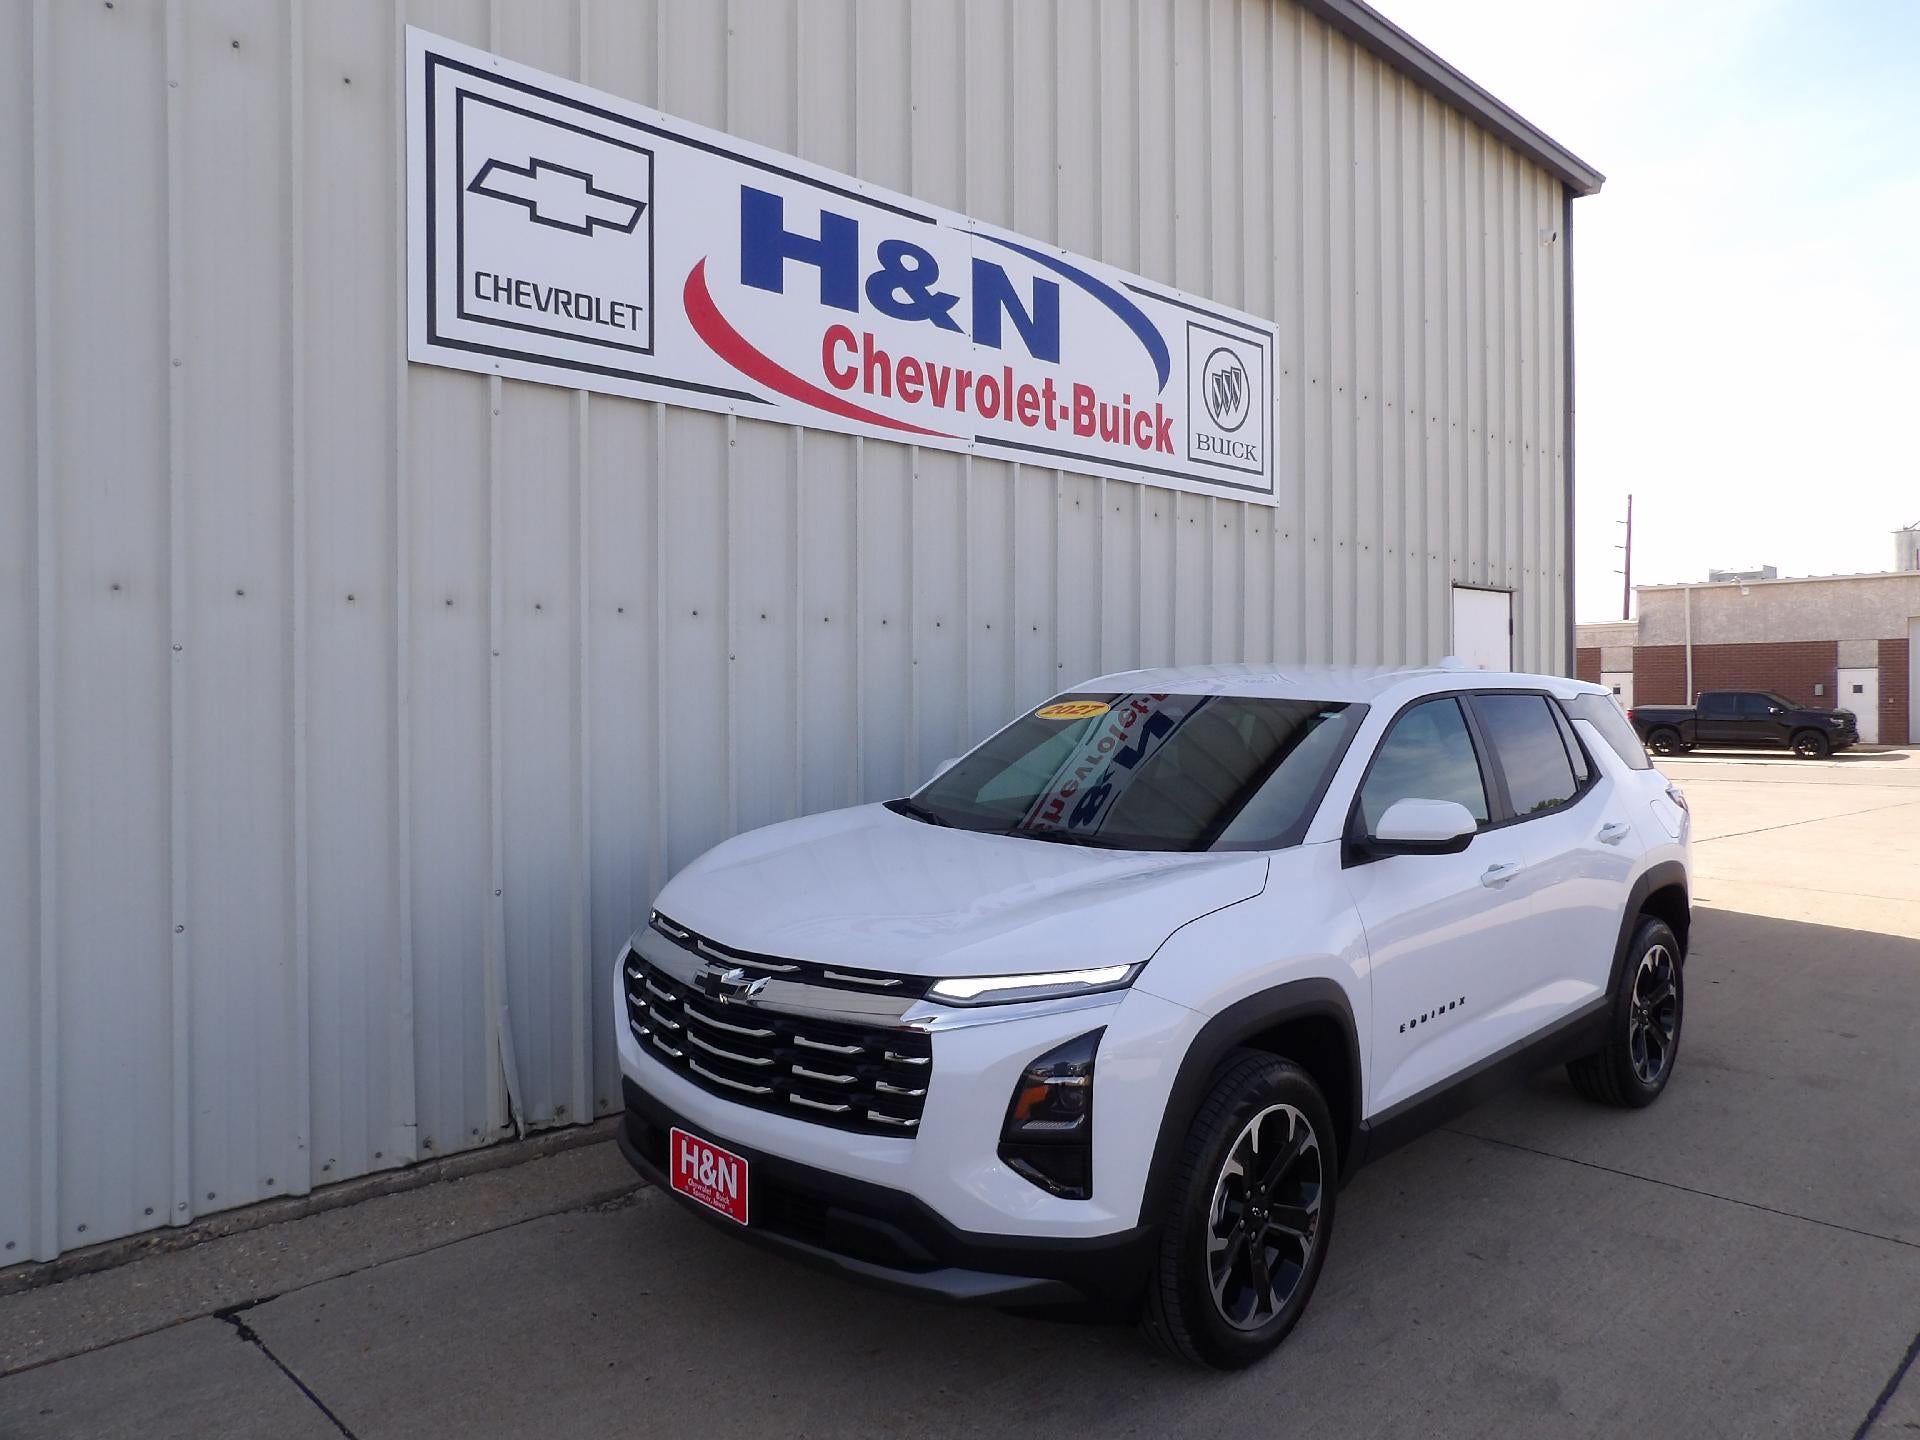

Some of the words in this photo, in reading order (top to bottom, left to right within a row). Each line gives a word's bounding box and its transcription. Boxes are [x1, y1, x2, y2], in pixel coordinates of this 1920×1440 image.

[474, 271, 643, 331] CHEVROLET
[740, 184, 1060, 364] H&N
[821, 324, 1175, 455] Chevrolet-Buick
[1195, 432, 1258, 462] BUICK
[1041, 703, 1105, 716] 2027
[1400, 996, 1465, 1033] EQUINOX
[681, 1139, 738, 1200] H&N
